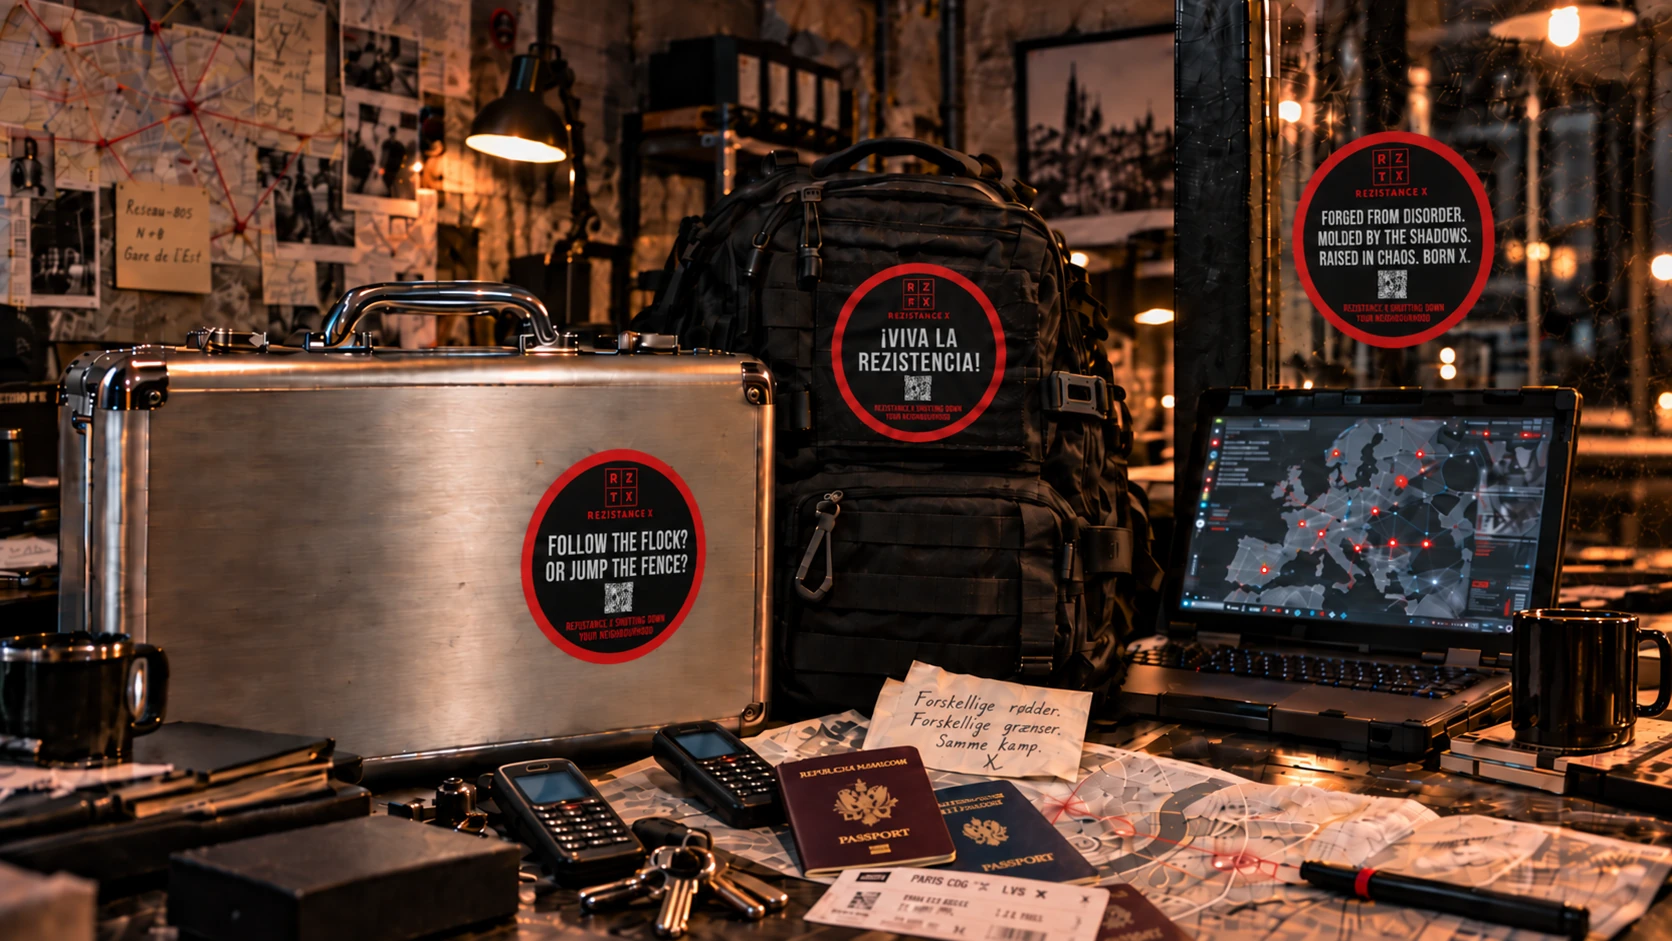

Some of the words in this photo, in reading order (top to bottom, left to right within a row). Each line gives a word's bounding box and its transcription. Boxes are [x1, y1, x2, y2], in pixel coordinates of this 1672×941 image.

[1377, 153, 1386, 165] R
[1395, 152, 1403, 163] Z
[1377, 171, 1386, 182] T
[1395, 170, 1403, 181] X
[1355, 187, 1419, 198] REZISTANCE
[1421, 187, 1428, 196] X
[1321, 209, 1364, 226] FORGED
[1367, 208, 1399, 225] FROM
[1403, 206, 1466, 224] DISORDER.
[1318, 230, 1362, 247] MOLDED
[1366, 229, 1381, 245] BY
[1384, 229, 1406, 245] THE
[1410, 227, 1471, 244] SHADOWS.
[124, 246, 149, 262] Gare
[155, 248, 168, 262] de
[1319, 250, 1359, 266] RAISED
[1362, 250, 1374, 265] IN
[1377, 249, 1419, 265] CHAOS.
[1423, 248, 1456, 264] BORN
[1459, 248, 1471, 264] X.
[907, 282, 915, 292] R
[922, 282, 930, 291] Z
[922, 297, 930, 307] X
[888, 311, 942, 320] REZISTANCE
[944, 311, 950, 320] X
[881, 328, 929, 349] ¡VIVA
[936, 328, 958, 348] LA
[858, 352, 980, 372] REZISTENCIA!
[609, 472, 618, 484] R
[625, 472, 633, 484] Z
[609, 491, 618, 503] T
[625, 491, 633, 502] X
[587, 509, 645, 520] REZISTANCE
[647, 508, 653, 518] X
[548, 532, 608, 556] FOLLOW
[612, 531, 637, 553] THE
[641, 529, 688, 551] FLOCK?
[545, 561, 565, 582] OR
[569, 559, 608, 581] JUMP
[612, 557, 637, 578] THE
[641, 554, 688, 576] FENCE?
[914, 690, 995, 717] Forskellige
[1009, 700, 1061, 717] rødder.
[910, 711, 991, 738] Forskellige
[1004, 721, 1061, 737] grænser.
[936, 734, 988, 751] Samme
[998, 737, 1042, 757] kamp.
[983, 753, 1003, 771] X
[838, 828, 910, 845] PASSPORT
[981, 852, 1054, 872] PASSPORT
[910, 874, 944, 886] PARIS
[947, 878, 969, 889] CDG
